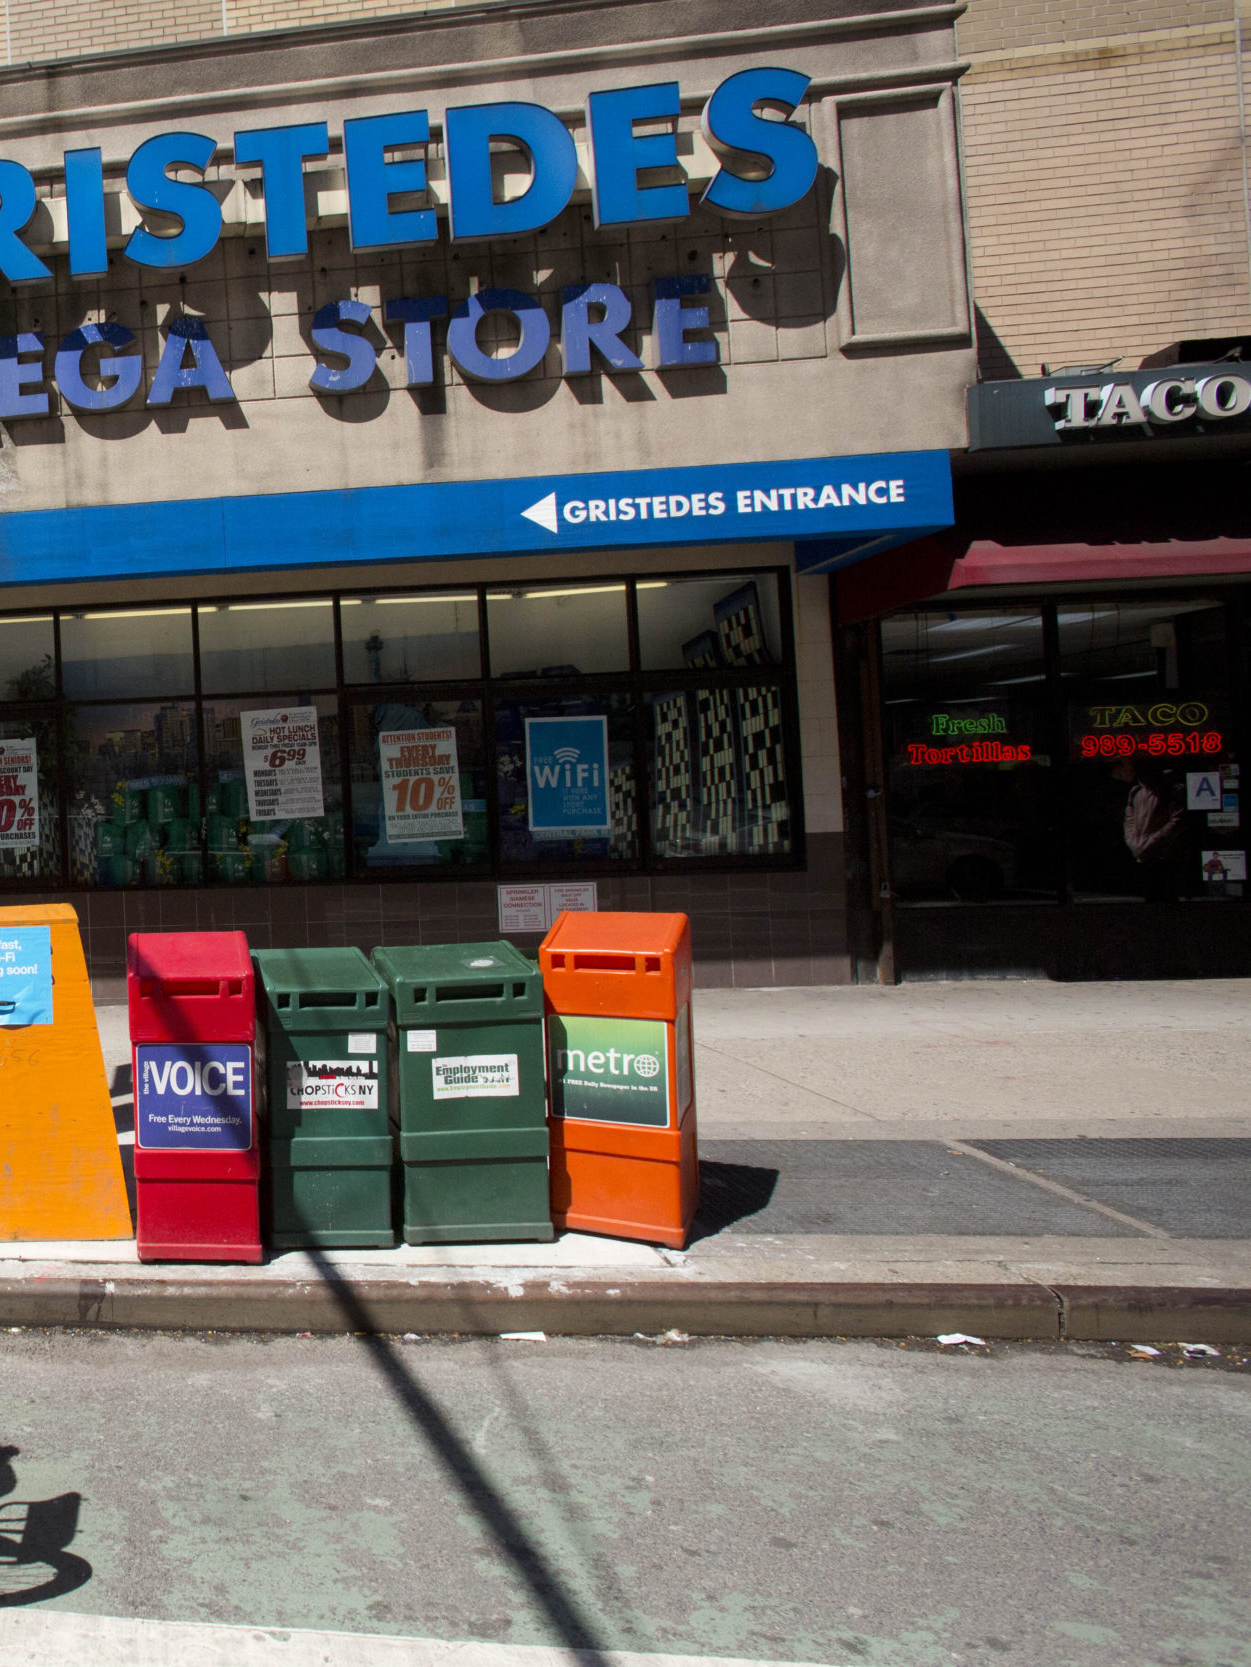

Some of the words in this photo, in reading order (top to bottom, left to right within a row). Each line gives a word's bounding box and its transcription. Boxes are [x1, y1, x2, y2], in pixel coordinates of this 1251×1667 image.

[309, 273, 719, 392] STORE
[1044, 373, 1251, 430] TACO
[563, 491, 726, 524] GRISTEDES
[737, 479, 905, 513] ENTRANCE
[931, 712, 1007, 735] Fresh
[1089, 702, 1209, 728] TACO
[269, 727, 286, 735] HOT
[288, 724, 315, 734] LUNCH
[252, 735, 274, 745] DAILY
[277, 732, 317, 743] SPECIALS
[382, 733, 415, 744] ATTENTION
[417, 730, 452, 740] STUDENTS!
[400, 743, 437, 757] EVERY
[908, 740, 1032, 765] Tortillas
[1081, 732, 1222, 757] 989-5518
[4, 755, 31, 766] SENIORS!
[387, 754, 452, 769] THURSDAY
[384, 768, 431, 778] STUDENTS
[433, 766, 455, 774] SAVE
[534, 763, 599, 788] WiFi
[1196, 776, 1216, 797] A
[436, 796, 455, 810] OFF
[17, 818, 35, 831] OFF
[6, 964, 38, 975] soon!
[435, 1063, 510, 1077] Employment
[556, 1048, 660, 1078] metro
[149, 1061, 245, 1097] VOICE
[444, 1074, 479, 1085] Guide
[584, 1080, 599, 1088] Daily
[599, 1082, 630, 1090] Newspaper
[357, 1085, 373, 1096] NY
[299, 1099, 365, 1107] www.chopsticksny.com
[148, 1114, 167, 1124] Free
[168, 1114, 191, 1125] Every
[192, 1115, 242, 1125] Wednesday.
[168, 1125, 222, 1133] villagevoice.com
